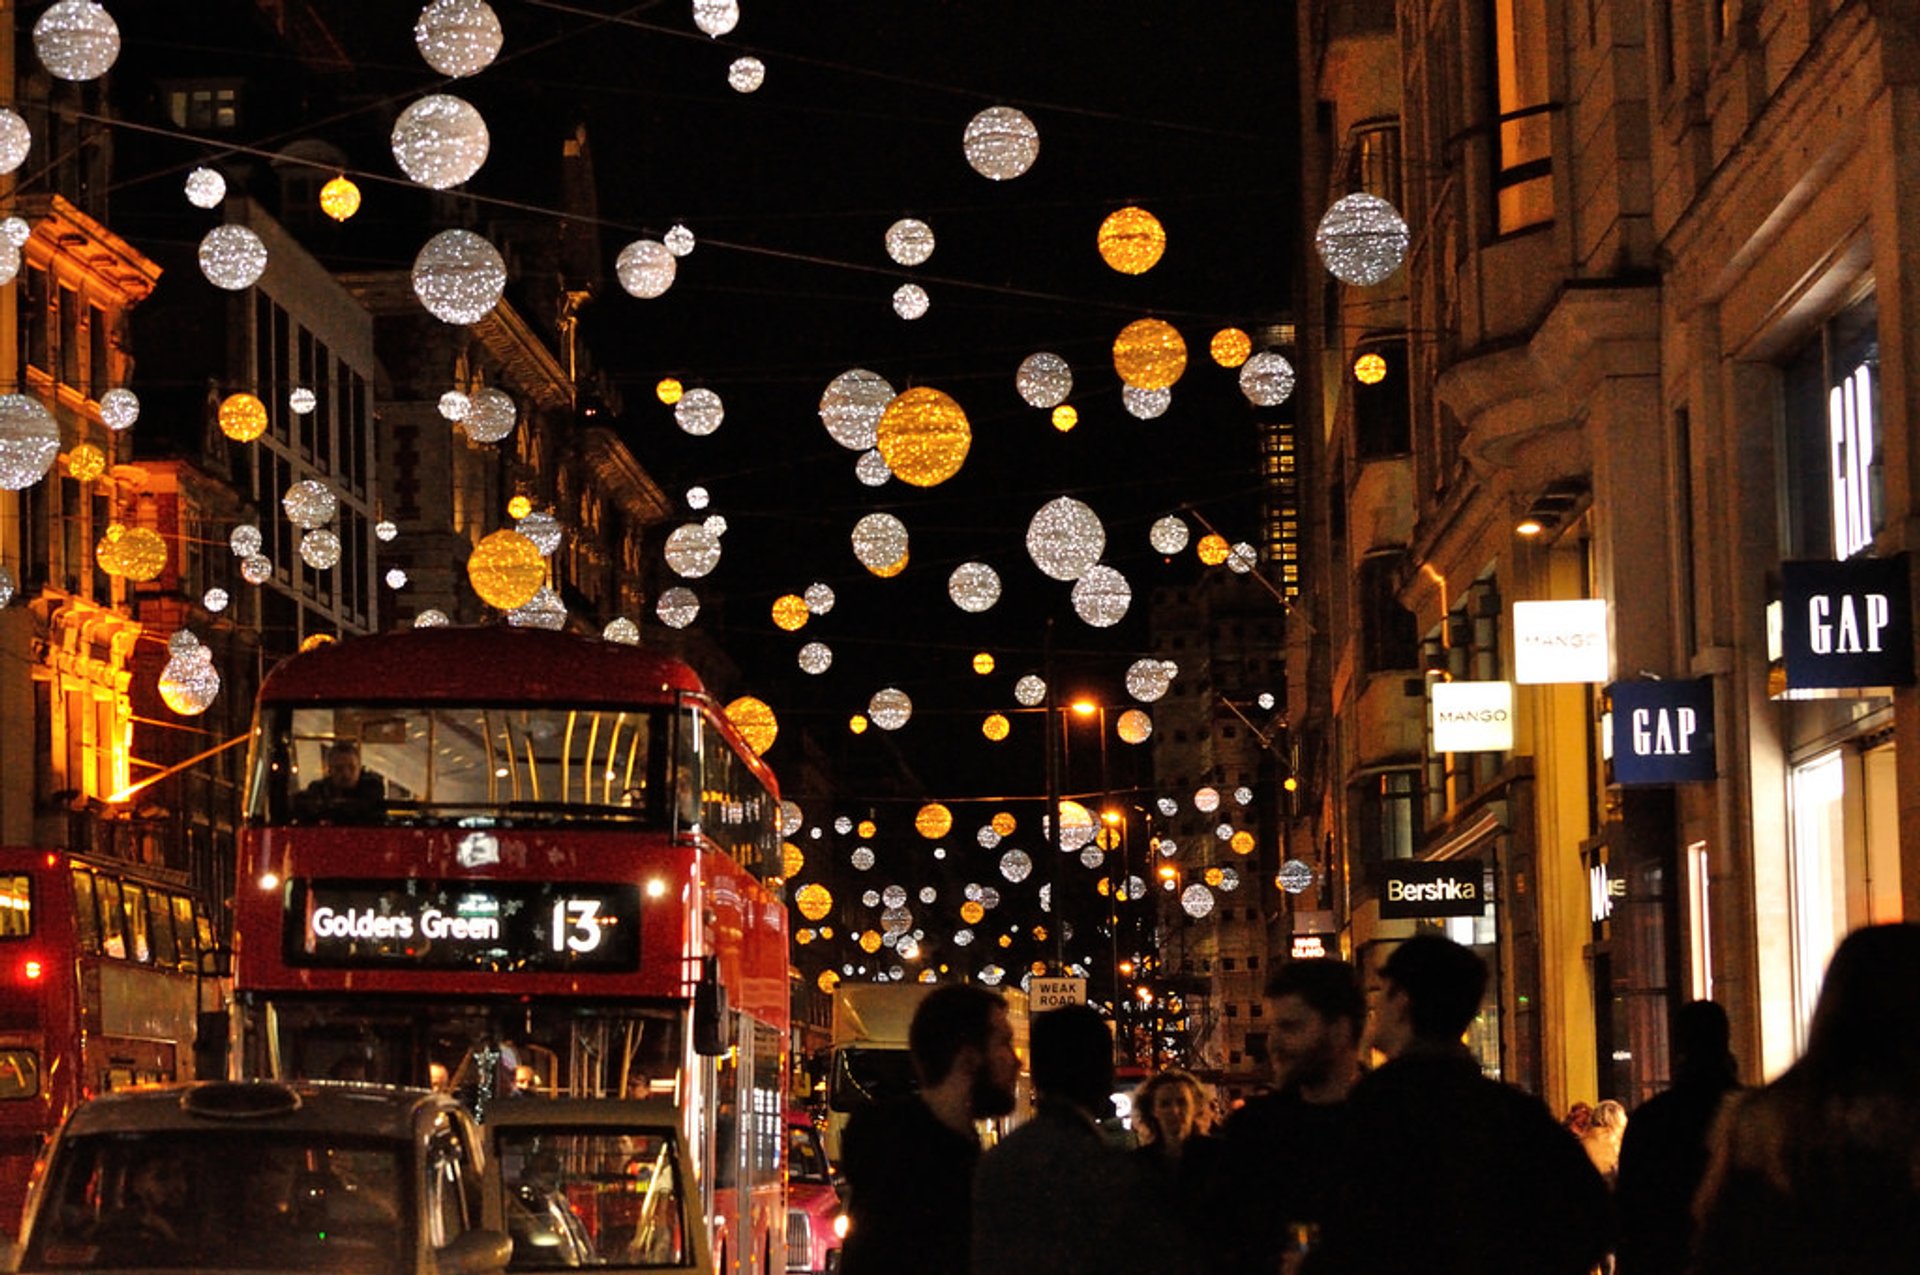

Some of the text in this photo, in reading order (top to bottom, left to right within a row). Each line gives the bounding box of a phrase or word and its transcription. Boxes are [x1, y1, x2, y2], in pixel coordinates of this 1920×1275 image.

[1809, 594, 1889, 654] GAP
[1439, 709, 1507, 723] MANGO
[1633, 707, 1697, 755] GAP
[1387, 877, 1476, 901] Bershka
[312, 900, 602, 952] Golders Green 13
[1039, 983, 1076, 993] WEAK
[1039, 995, 1076, 1006] ROAD
